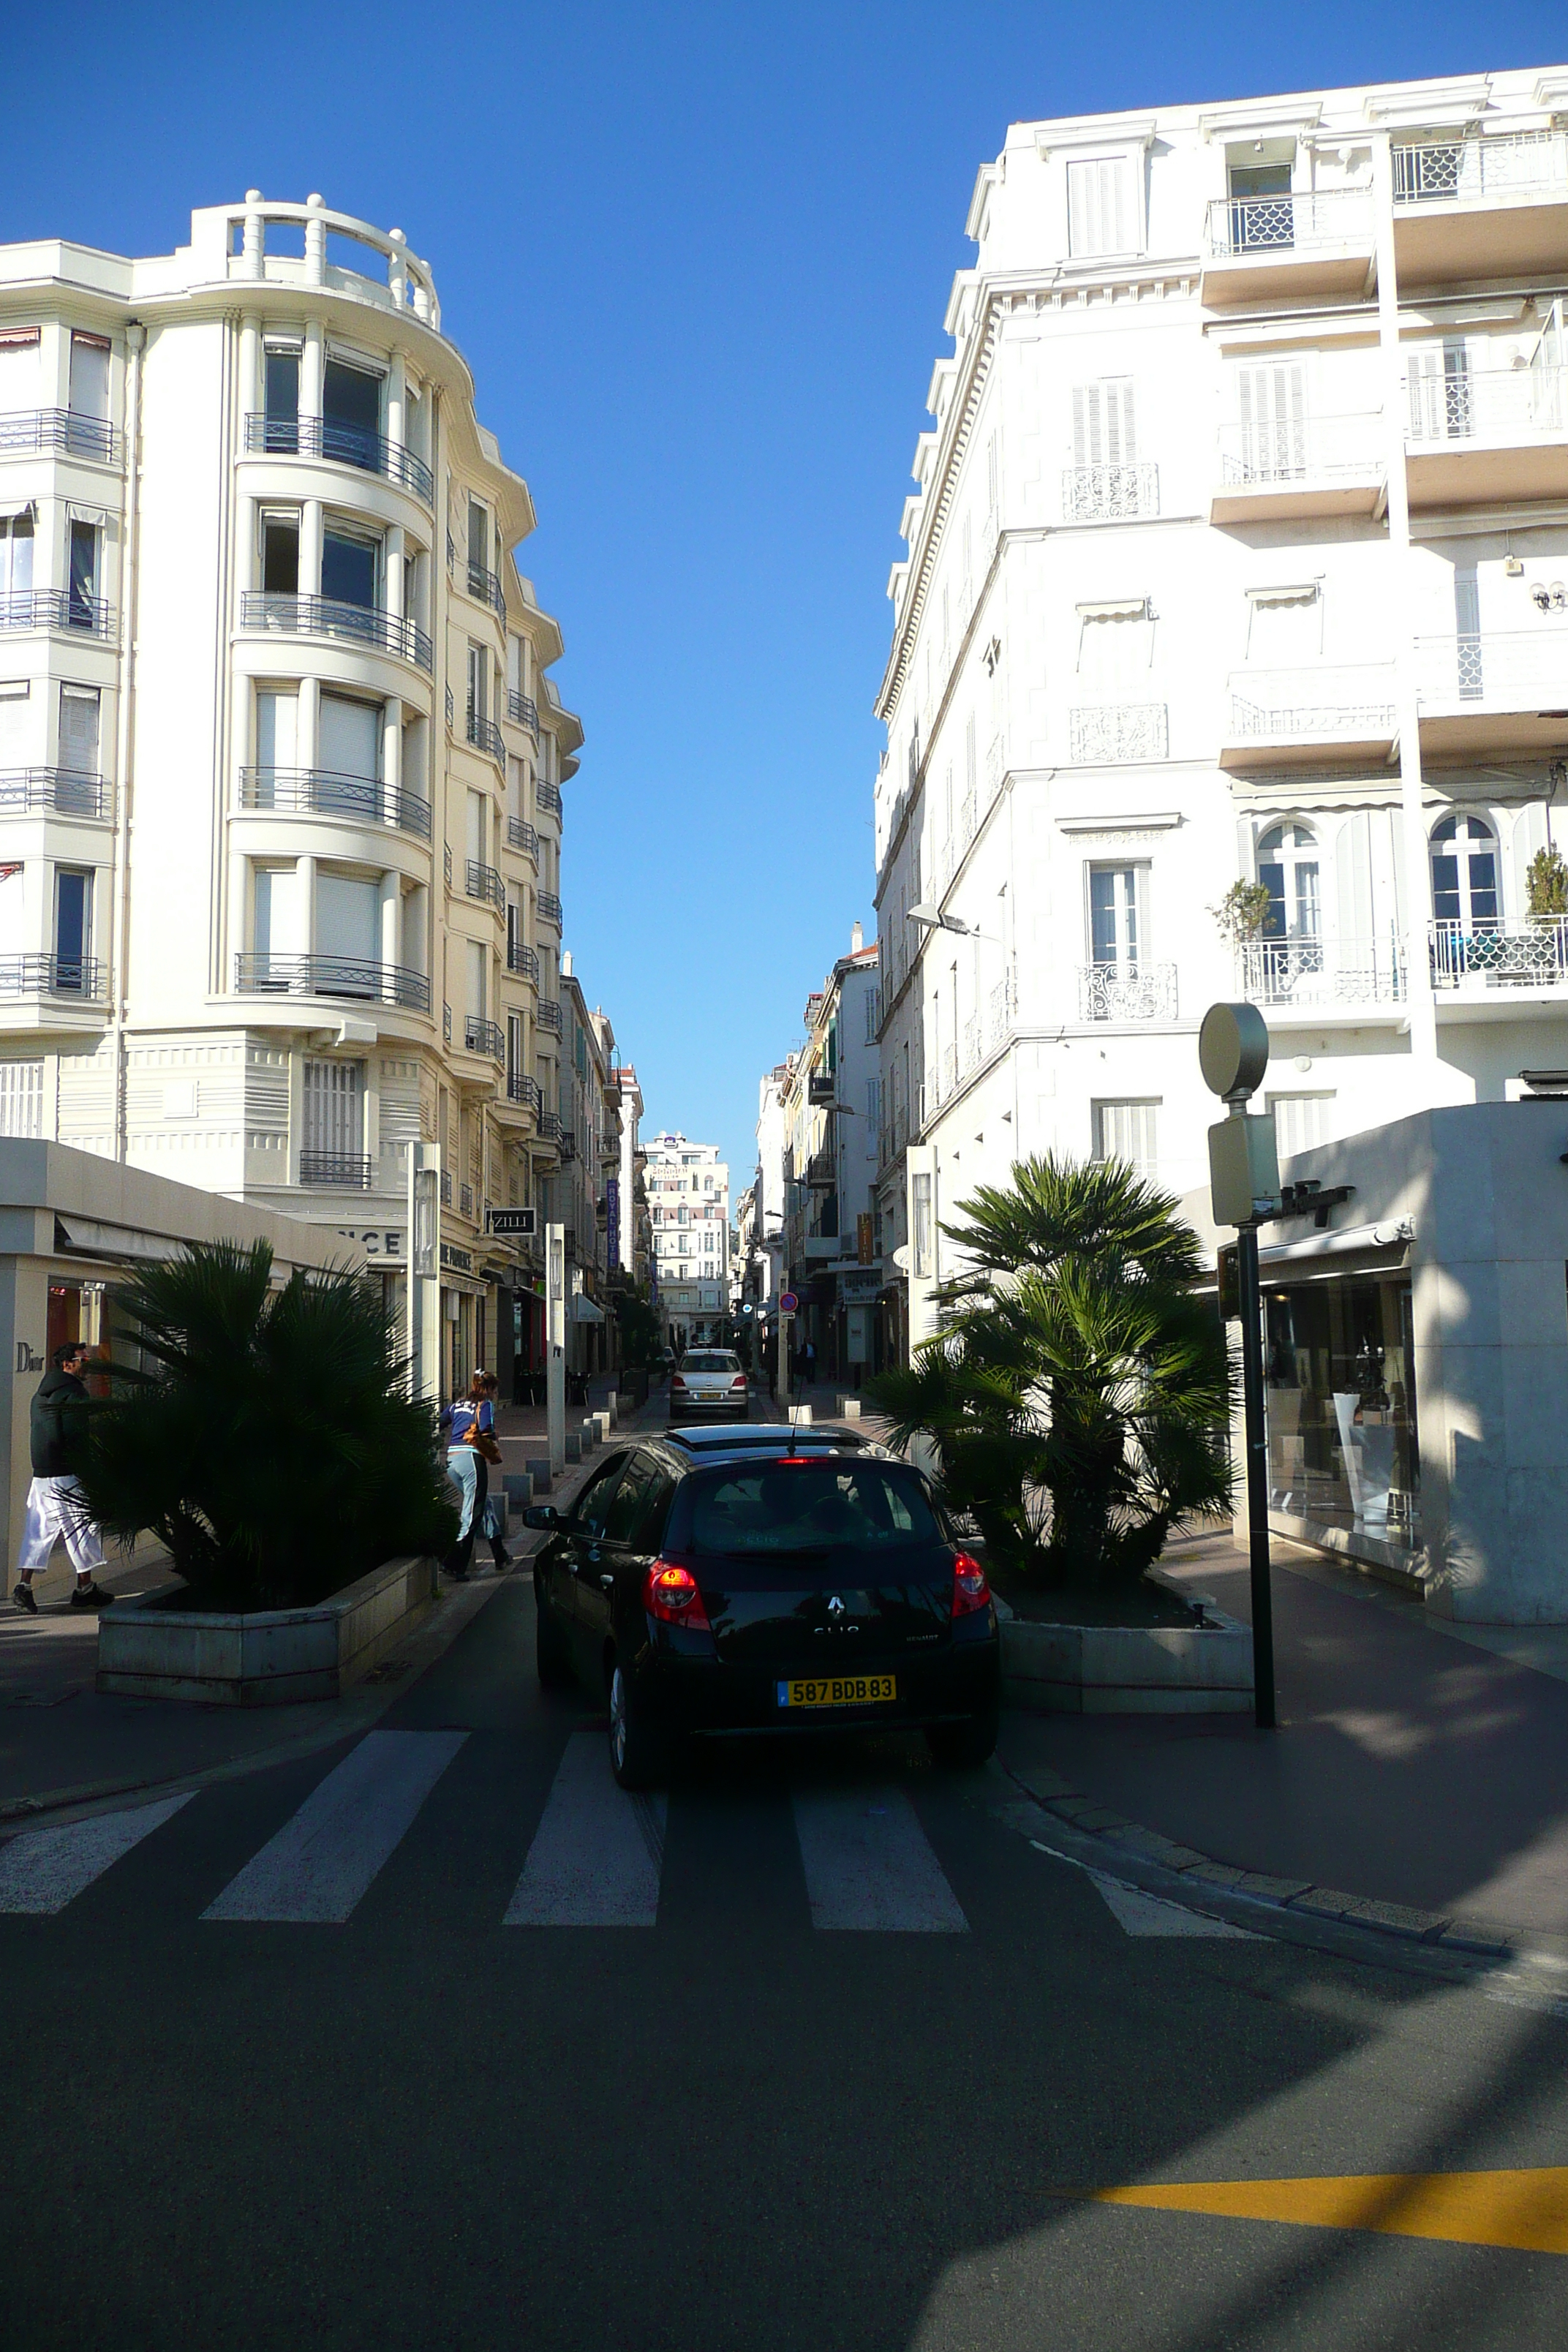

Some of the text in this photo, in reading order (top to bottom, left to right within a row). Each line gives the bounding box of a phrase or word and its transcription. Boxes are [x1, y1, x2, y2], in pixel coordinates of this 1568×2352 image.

[494, 1215, 527, 1229] ZILLI
[608, 1187, 617, 1267] ROYAL HOTEL
[16, 1341, 45, 1372] Dior
[813, 1625, 859, 1635] CLIO
